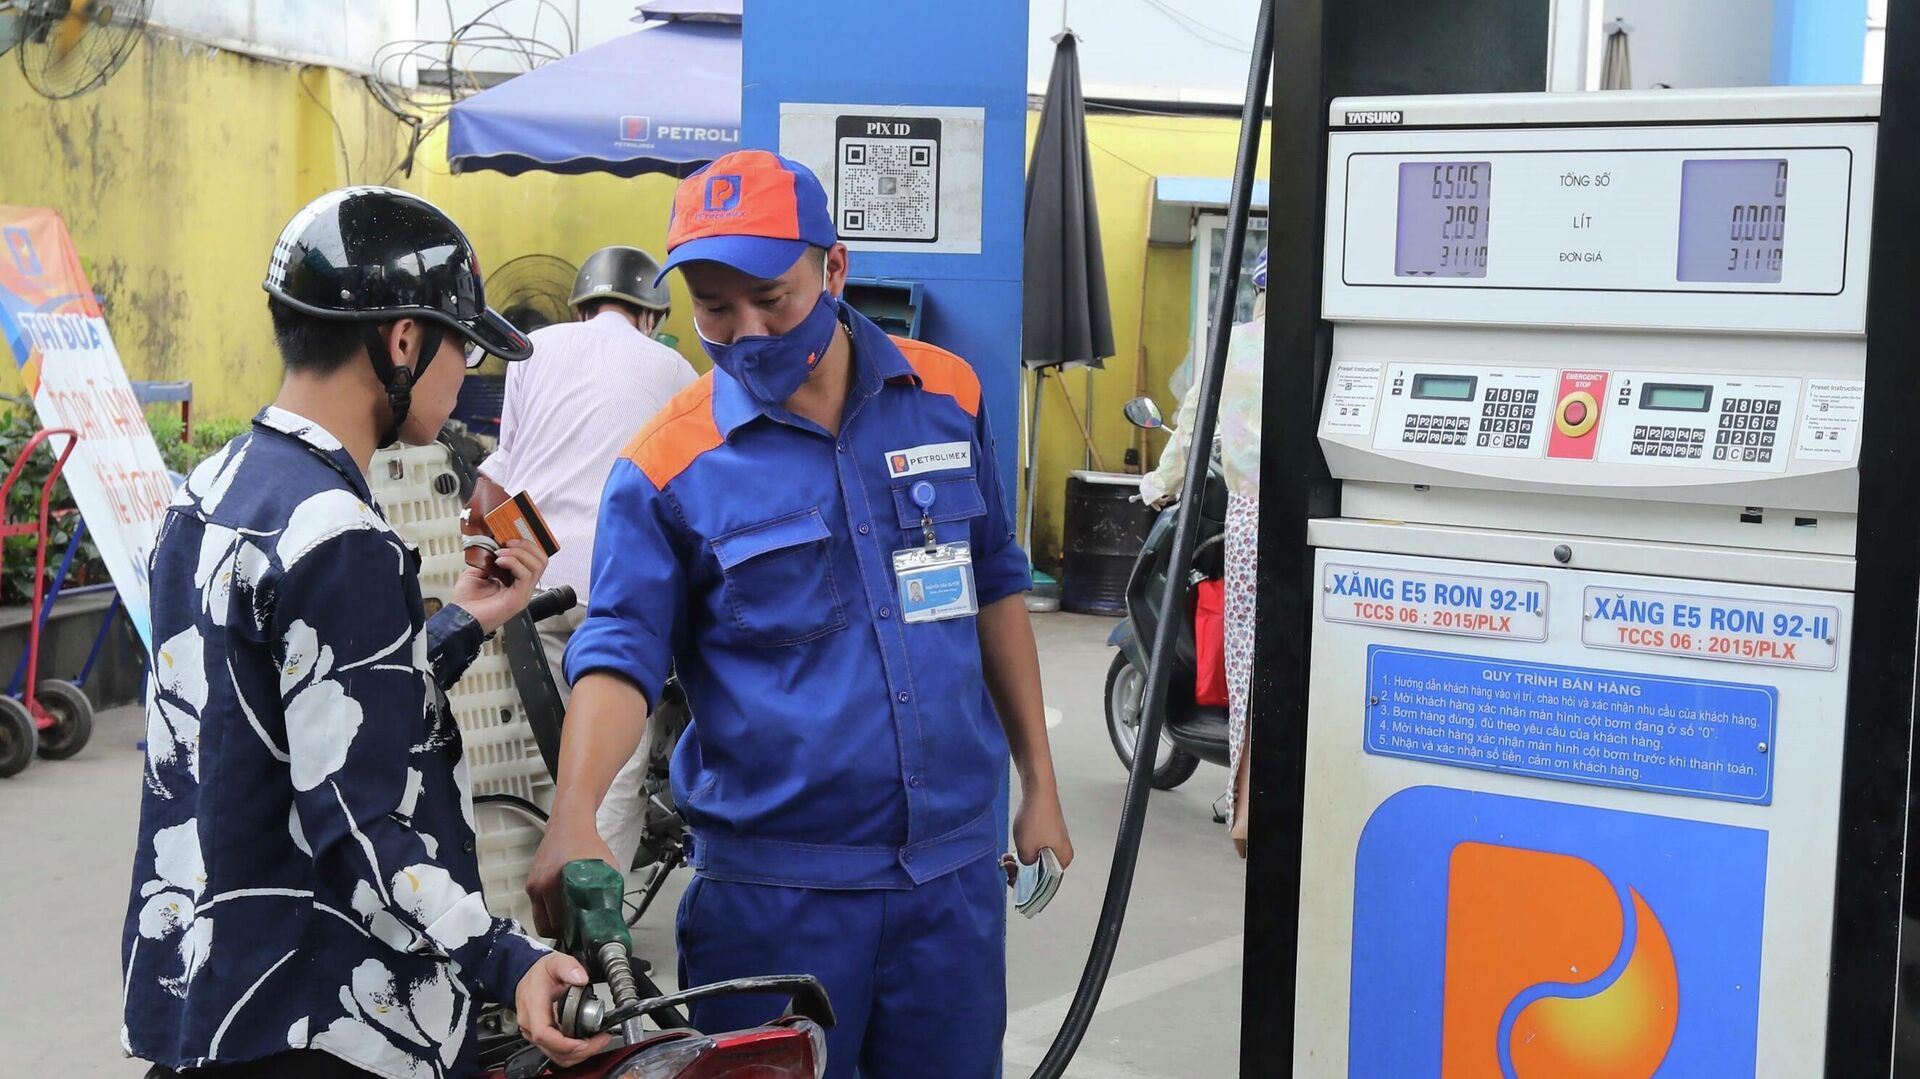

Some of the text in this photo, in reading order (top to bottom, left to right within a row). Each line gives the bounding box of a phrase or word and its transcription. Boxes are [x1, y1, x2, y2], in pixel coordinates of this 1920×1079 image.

[866, 122, 911, 136] PIX ID
[1347, 112, 1400, 124] TATSUNO
[657, 126, 739, 143] PETROLI
[1573, 213, 1592, 229] LÍT
[1584, 250, 1603, 263] GIÁ
[19, 313, 62, 350] THI
[1566, 373, 1603, 381] EMERGENCY
[910, 452, 967, 465] PETROLIMEX
[1333, 571, 1394, 599] XĂNG
[1402, 581, 1426, 603] E5
[1434, 584, 1482, 608] RON
[1354, 603, 1394, 620] TCCS
[1400, 608, 1417, 623] 06
[1433, 611, 1511, 632] 2015/PLX
[1594, 594, 1828, 640] XĂNG E5 RON 92-II
[1618, 627, 1664, 647] TCCS
[1670, 633, 1691, 650] 06
[1708, 636, 1796, 659] 2015/PLX
[1483, 670, 1641, 696] QUY TRÌNH BÁN HÀNG
[1381, 691, 1390, 701] 2.
[1394, 692, 1413, 703] Mời
[1416, 695, 1446, 708] khách
[1449, 699, 1474, 712] hàng
[1478, 702, 1496, 713] xác
[1500, 705, 1526, 718] nhận
[1530, 708, 1552, 720] màn
[1584, 715, 1601, 728] cột
[1604, 717, 1631, 728] bơm
[1635, 721, 1663, 735] đang
[1668, 723, 1676, 734] ở
[1383, 675, 1391, 685] 1.
[1444, 681, 1468, 694] khách
[1472, 686, 1492, 699] hàng
[1495, 689, 1510, 699] vào
[1514, 690, 1520, 702] vị
[1537, 693, 1559, 705] chào
[1578, 698, 1589, 708] và
[1592, 699, 1608, 710] xác
[1611, 701, 1634, 714] nhận
[1638, 705, 1655, 715] nhu
[1658, 704, 1675, 717] cầu
[1700, 710, 1728, 723] khách
[1732, 713, 1759, 729] hàng.
[1381, 705, 1389, 715] 3.
[1393, 706, 1417, 718] Bơm
[1421, 710, 1445, 724] hàng
[1498, 720, 1520, 731] theo
[1523, 724, 1542, 735] yêu
[1546, 723, 1566, 737] cầu
[1593, 731, 1627, 744] khách
[1632, 736, 1663, 751] hàng.
[1380, 720, 1389, 730] 4.
[1392, 721, 1412, 732] Mời
[1415, 725, 1445, 737] khách
[1448, 729, 1473, 744] hàng
[1477, 732, 1495, 744] xác
[1498, 736, 1524, 749] nhận
[1528, 739, 1552, 751] màn
[1583, 746, 1600, 758] cột
[1604, 748, 1629, 760] bơm
[1634, 751, 1665, 765] trước
[1669, 755, 1686, 767] khi
[1690, 758, 1723, 772] thanh
[1728, 762, 1757, 776] toán.
[1380, 735, 1388, 745] 5.
[1392, 736, 1418, 750] Nhận
[1422, 740, 1433, 751] và
[1437, 742, 1454, 753] xác
[1458, 745, 1483, 759] nhận
[1554, 758, 1569, 768] ơn
[1573, 760, 1606, 773] khách
[1610, 764, 1642, 779] hàng.
